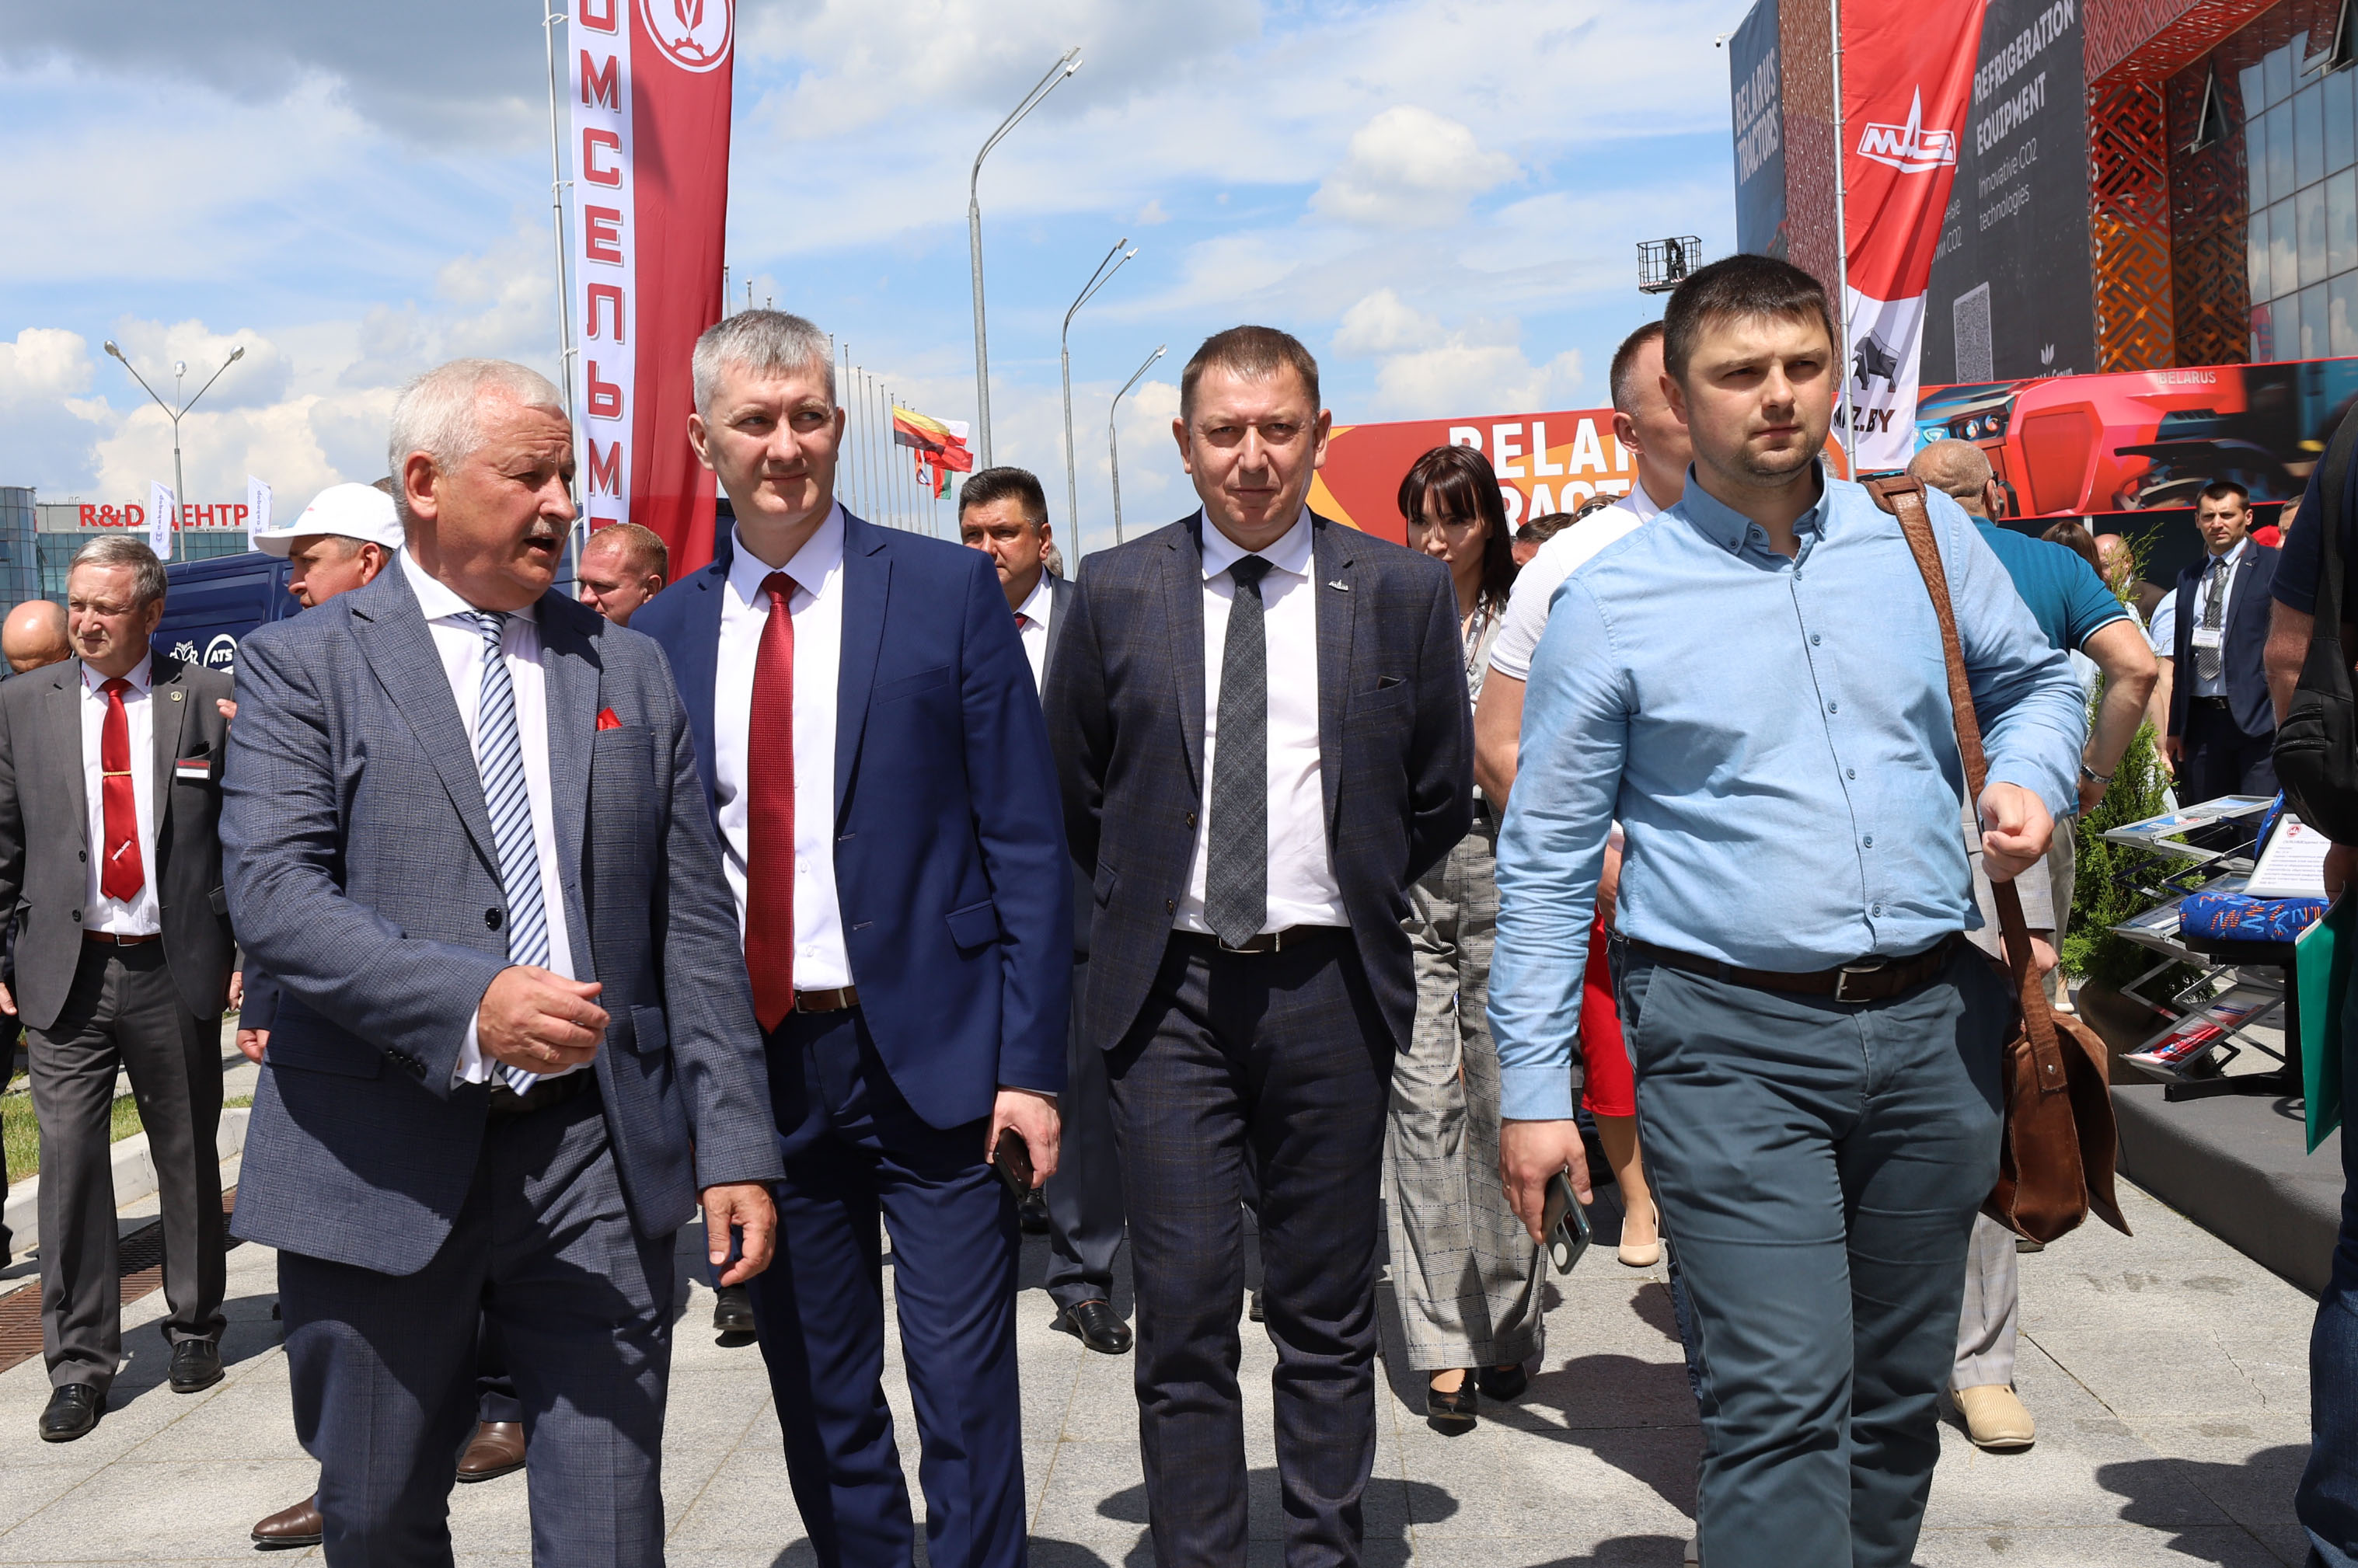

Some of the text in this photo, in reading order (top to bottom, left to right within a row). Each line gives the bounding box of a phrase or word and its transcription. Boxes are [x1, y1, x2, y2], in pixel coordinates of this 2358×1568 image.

[1974, 0, 2074, 106] REFRIGERATION
[1735, 47, 1776, 138] BELARUS
[1976, 71, 2046, 156] EQUIPMENT
[1738, 101, 1779, 186] TRACTORS
[1979, 138, 2037, 200] Innovative CO2
[1980, 183, 2029, 232] technologies
[2158, 371, 2217, 384] BELARUS
[79, 504, 249, 531] R&D ЕНТР
